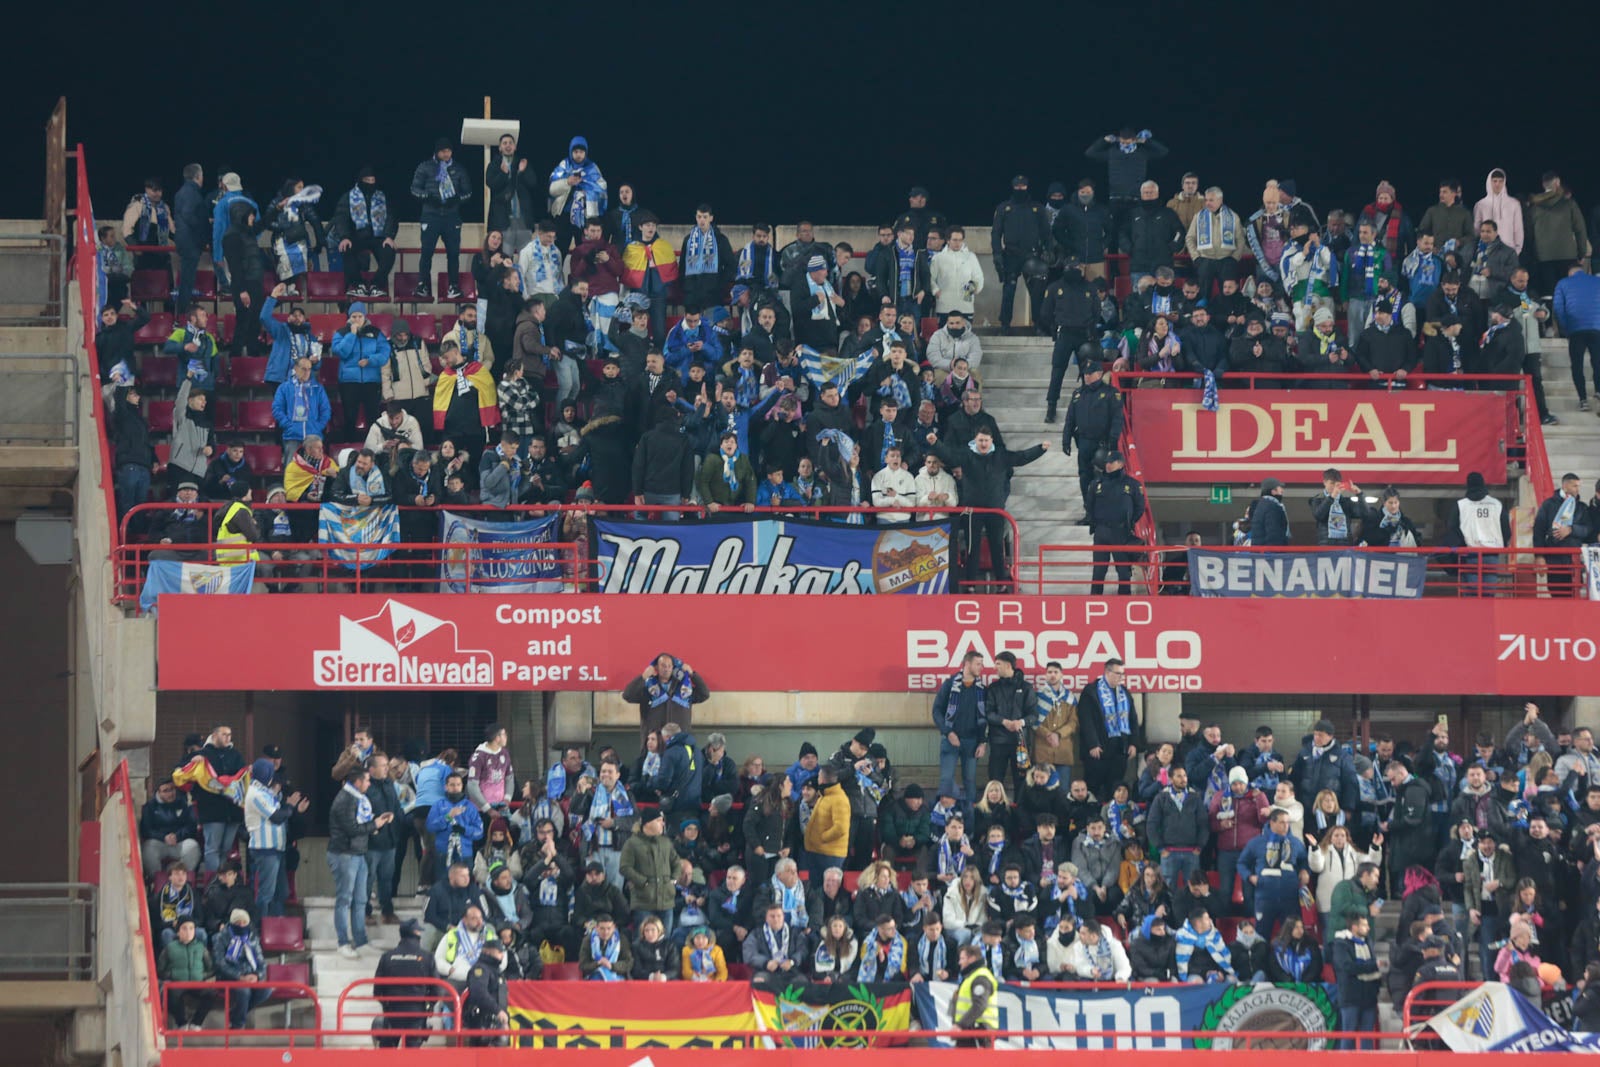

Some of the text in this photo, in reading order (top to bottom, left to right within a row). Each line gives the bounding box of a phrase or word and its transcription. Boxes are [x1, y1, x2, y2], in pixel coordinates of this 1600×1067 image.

[1172, 403, 1457, 459] IDEAL
[1476, 507, 1489, 519] 69
[600, 533, 868, 594] Malakas
[1197, 556, 1417, 596] BENAMIEL
[495, 604, 602, 629] Compost
[954, 600, 1152, 625] GRUPO
[527, 634, 572, 656] and
[907, 630, 1202, 669] BARCALO
[1497, 634, 1597, 661] AUTO
[502, 661, 608, 686] Paper S.L.
